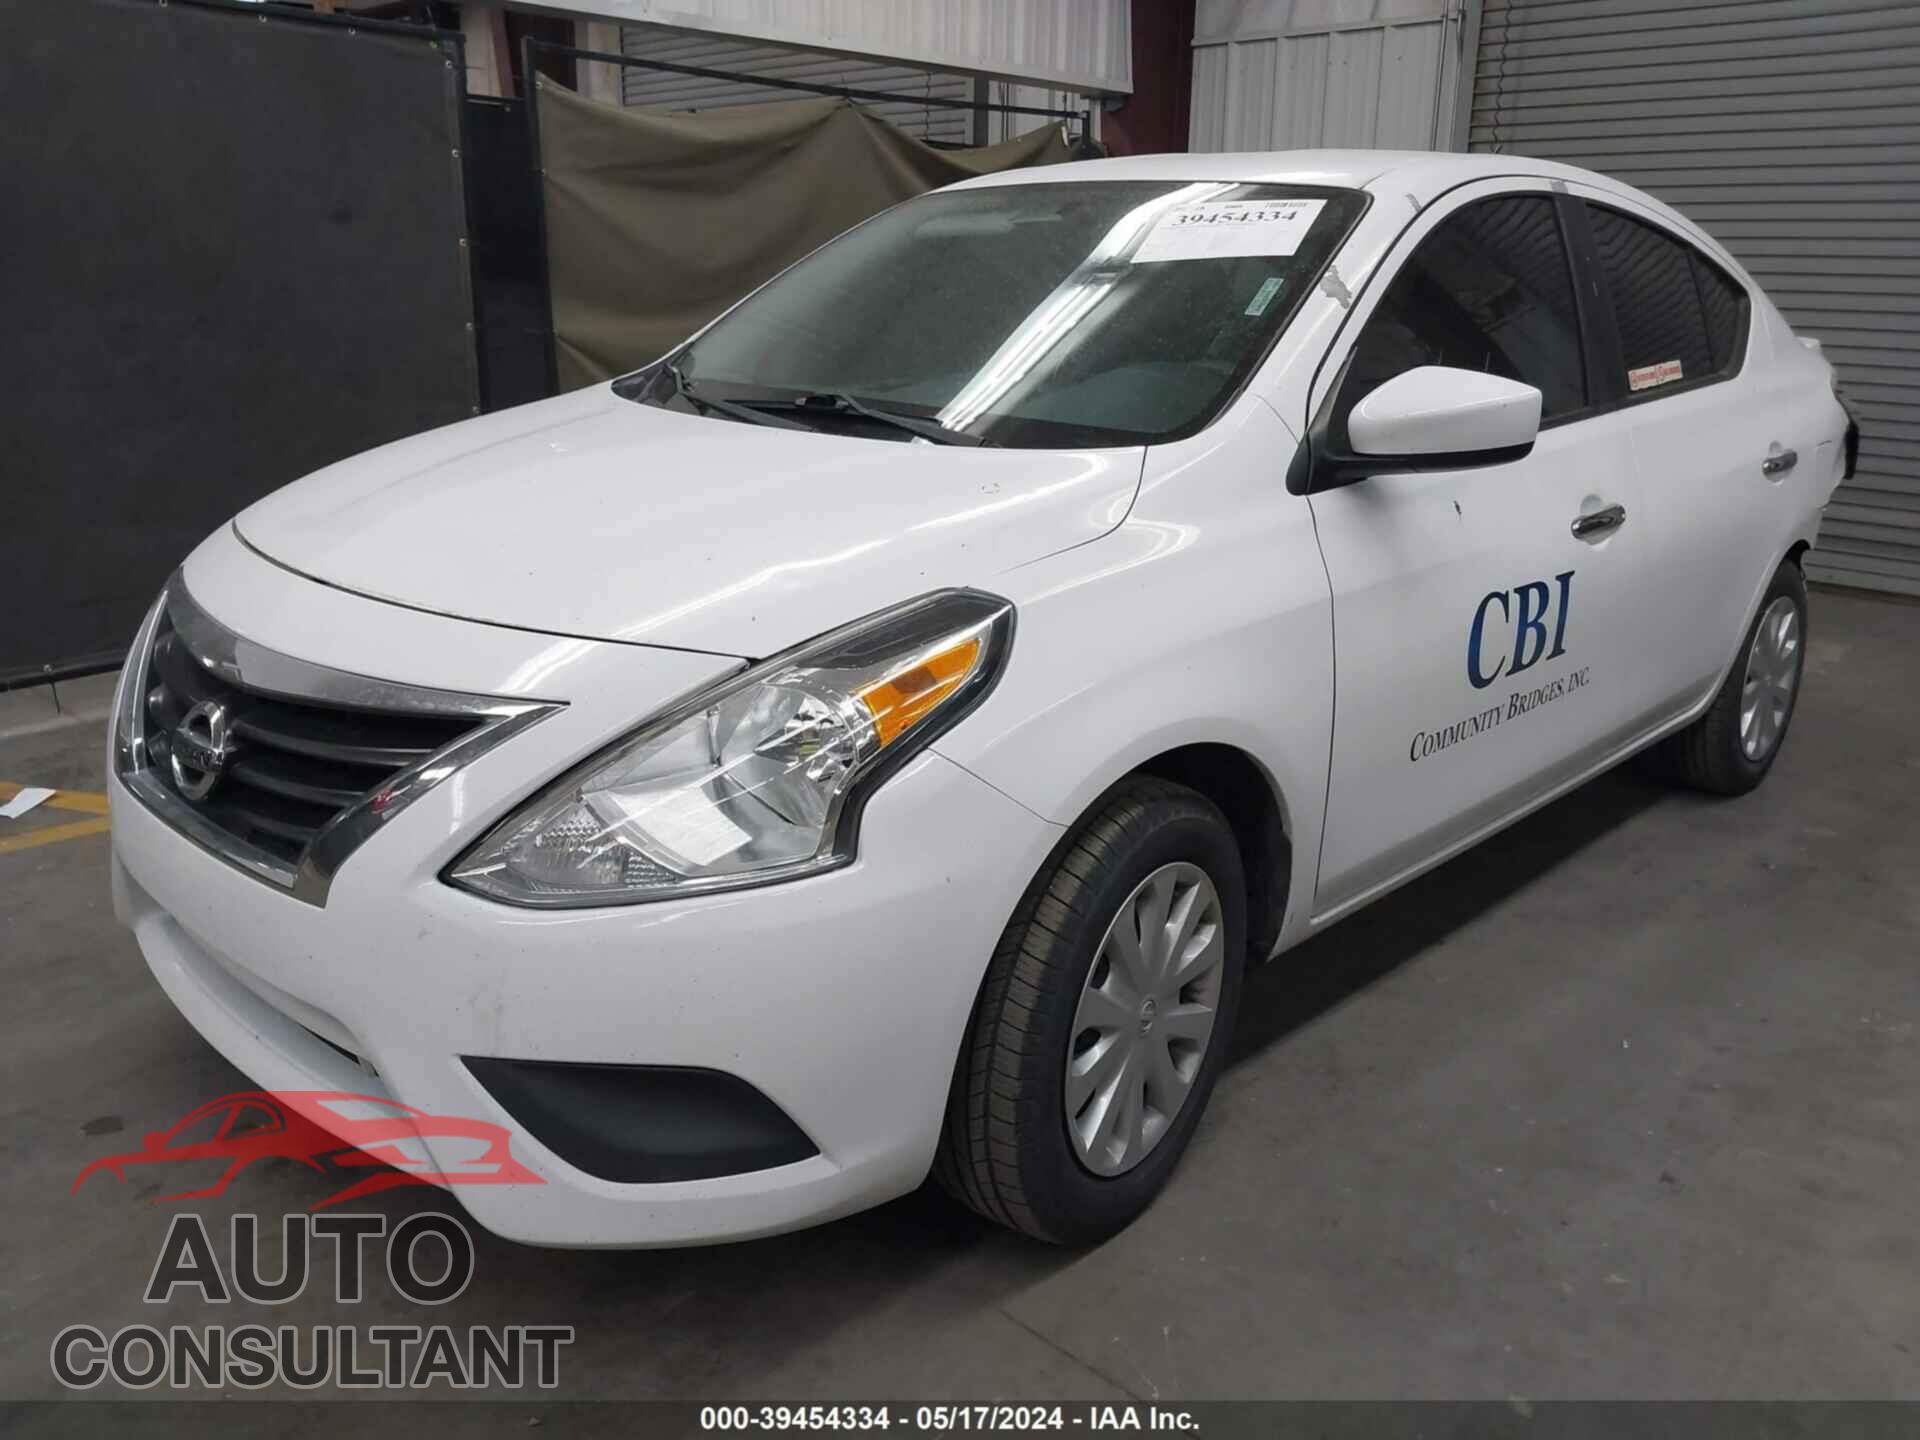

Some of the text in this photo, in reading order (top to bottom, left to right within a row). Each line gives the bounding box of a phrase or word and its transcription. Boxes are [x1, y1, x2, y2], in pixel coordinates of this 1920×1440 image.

[1172, 210, 1298, 225] 39454334
[1467, 570, 1576, 689] CBI
[1409, 666, 1590, 762] COMMUNITY BRIDGES, INC.
